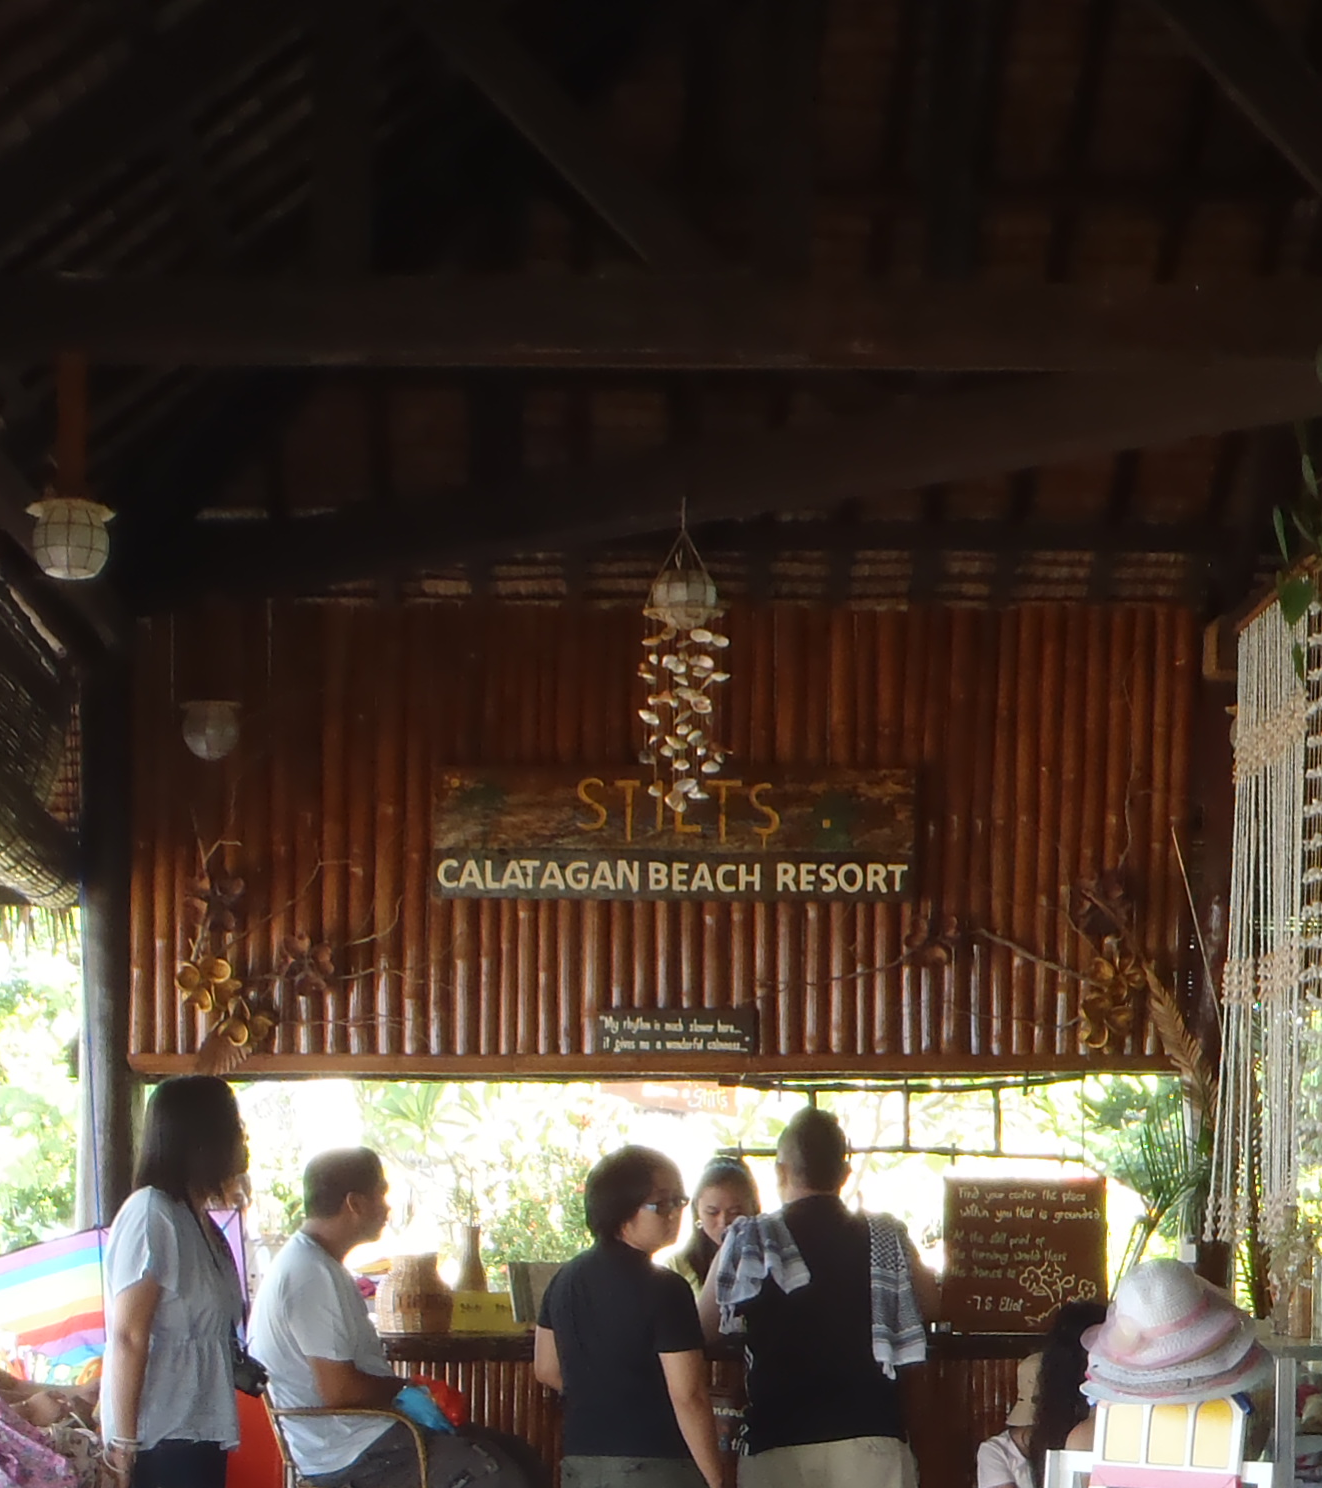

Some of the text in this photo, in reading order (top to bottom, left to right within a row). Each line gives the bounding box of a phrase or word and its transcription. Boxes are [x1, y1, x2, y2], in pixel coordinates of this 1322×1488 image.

[576, 777, 780, 846] STILTS
[436, 859, 908, 894] CALATAGAN BEACH RESORT
[665, 1036, 704, 1050] wonderful
[958, 1186, 980, 1199] Find
[984, 1192, 1005, 1204] your
[959, 1203, 990, 1218] within
[994, 1209, 1013, 1223] you
[1052, 1207, 1101, 1224] grounded
